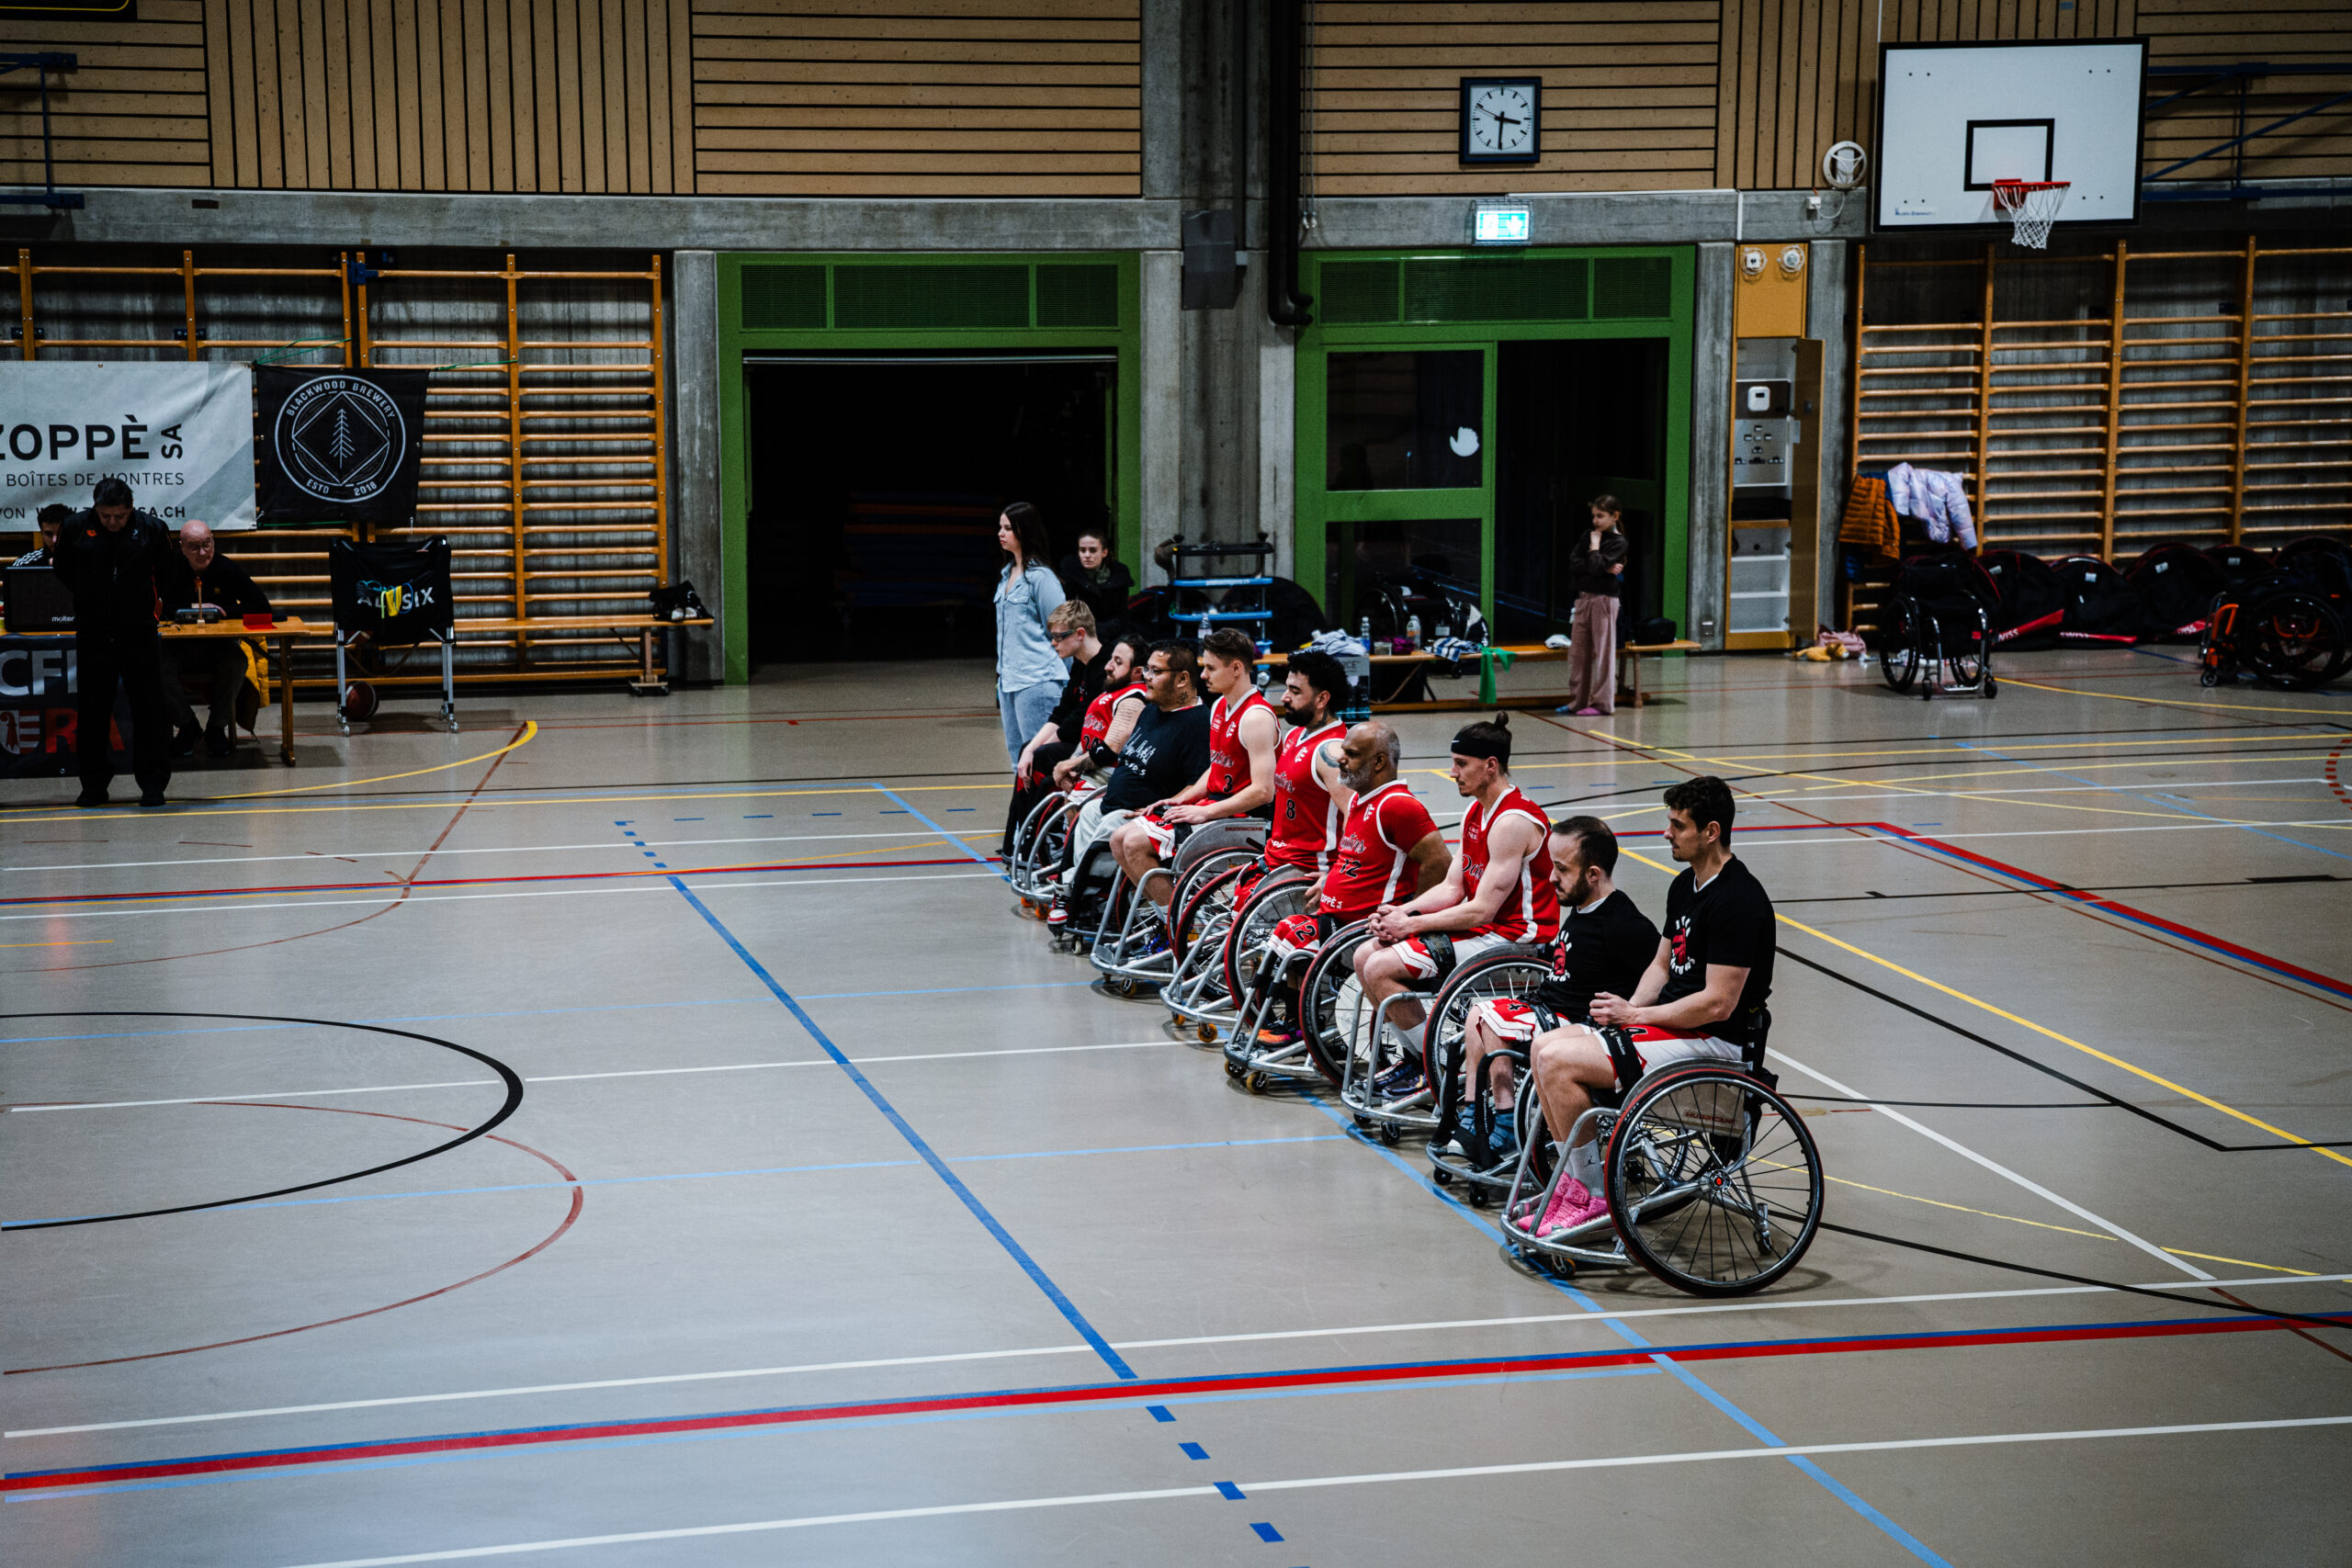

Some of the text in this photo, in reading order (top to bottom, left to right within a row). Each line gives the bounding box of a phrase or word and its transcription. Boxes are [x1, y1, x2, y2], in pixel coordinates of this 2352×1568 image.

[286, 380, 395, 419] BLACKWOOD BREWERY
[0, 414, 150, 460] OPPÈ
[161, 423, 183, 459] SA
[6, 470, 68, 487] BOÎTES
[74, 472, 96, 485] DE
[306, 479, 378, 496] ESTD 2018
[1223, 773, 1233, 793] 3
[1286, 798, 1296, 820] 8
